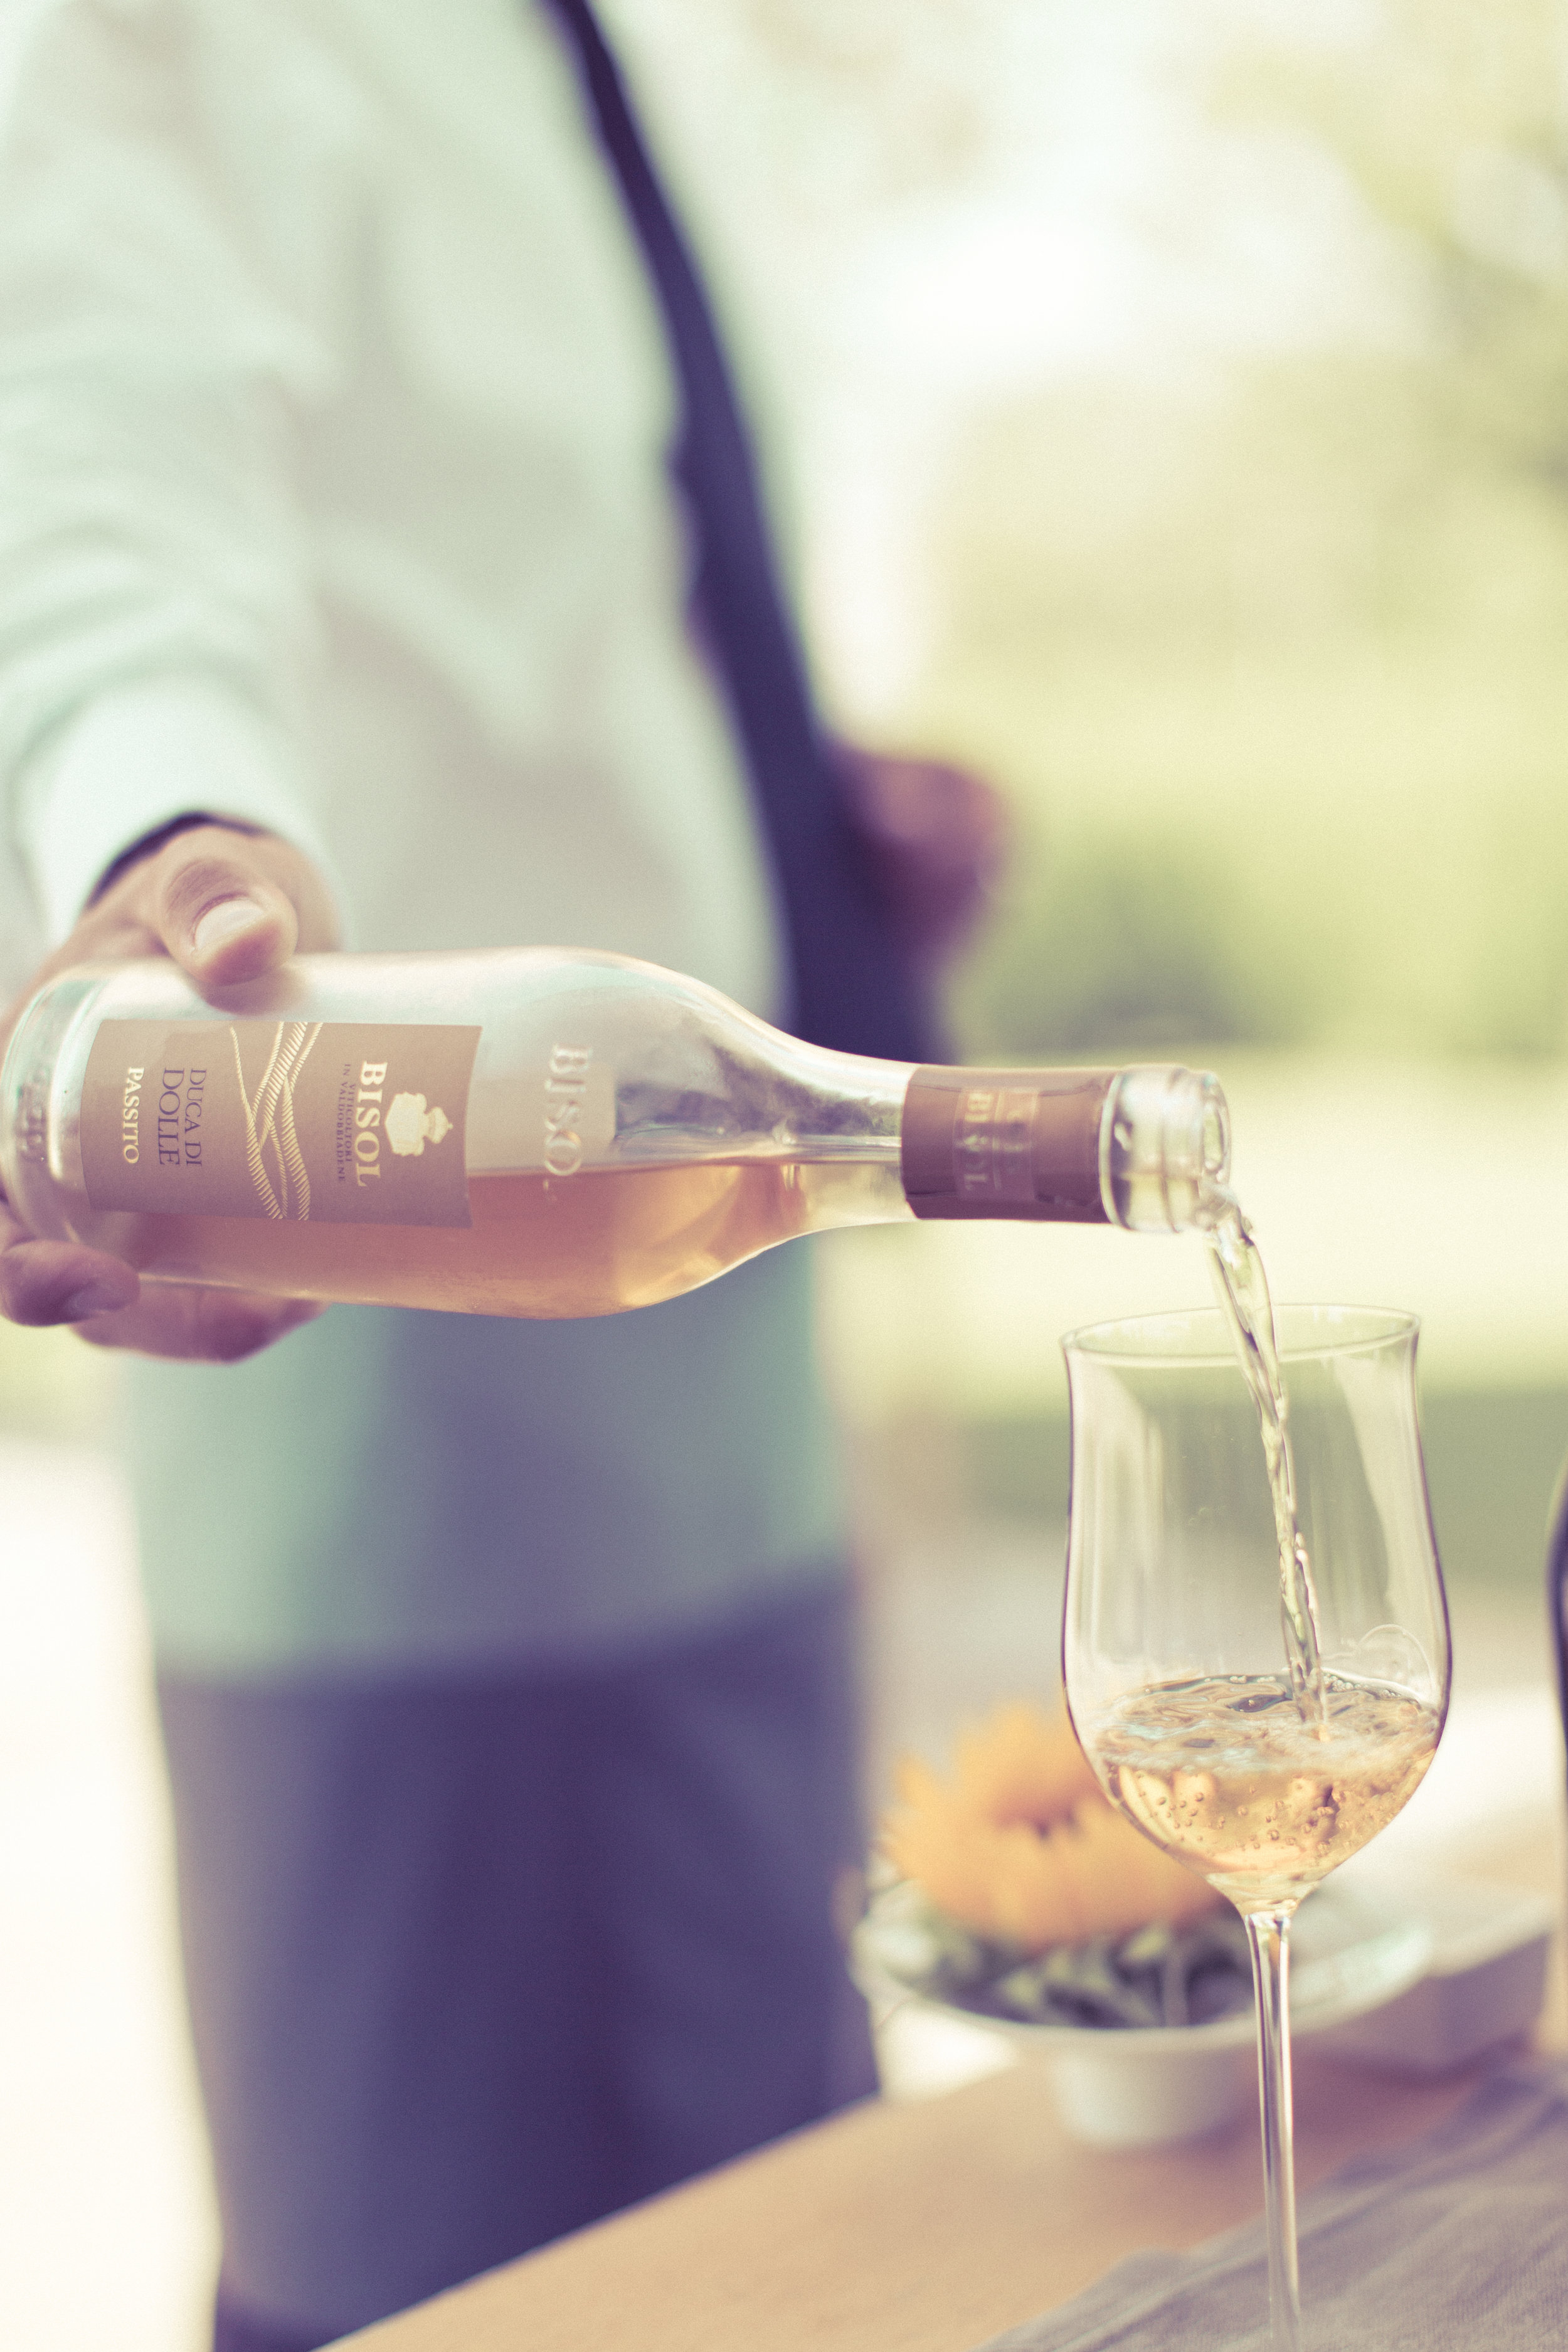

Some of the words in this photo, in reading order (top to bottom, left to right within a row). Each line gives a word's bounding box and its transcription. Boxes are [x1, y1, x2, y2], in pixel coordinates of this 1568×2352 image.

[185, 1068, 207, 1134] DUCA
[343, 1063, 352, 1076] IN
[122, 1066, 145, 1164] PASSITO
[157, 1067, 184, 1165] DOLLE
[185, 1140, 203, 1168] DI
[336, 1081, 348, 1182] VALDOBBIADENE
[345, 1083, 356, 1162] VITICOLTORI
[354, 1060, 388, 1187] BISOL
